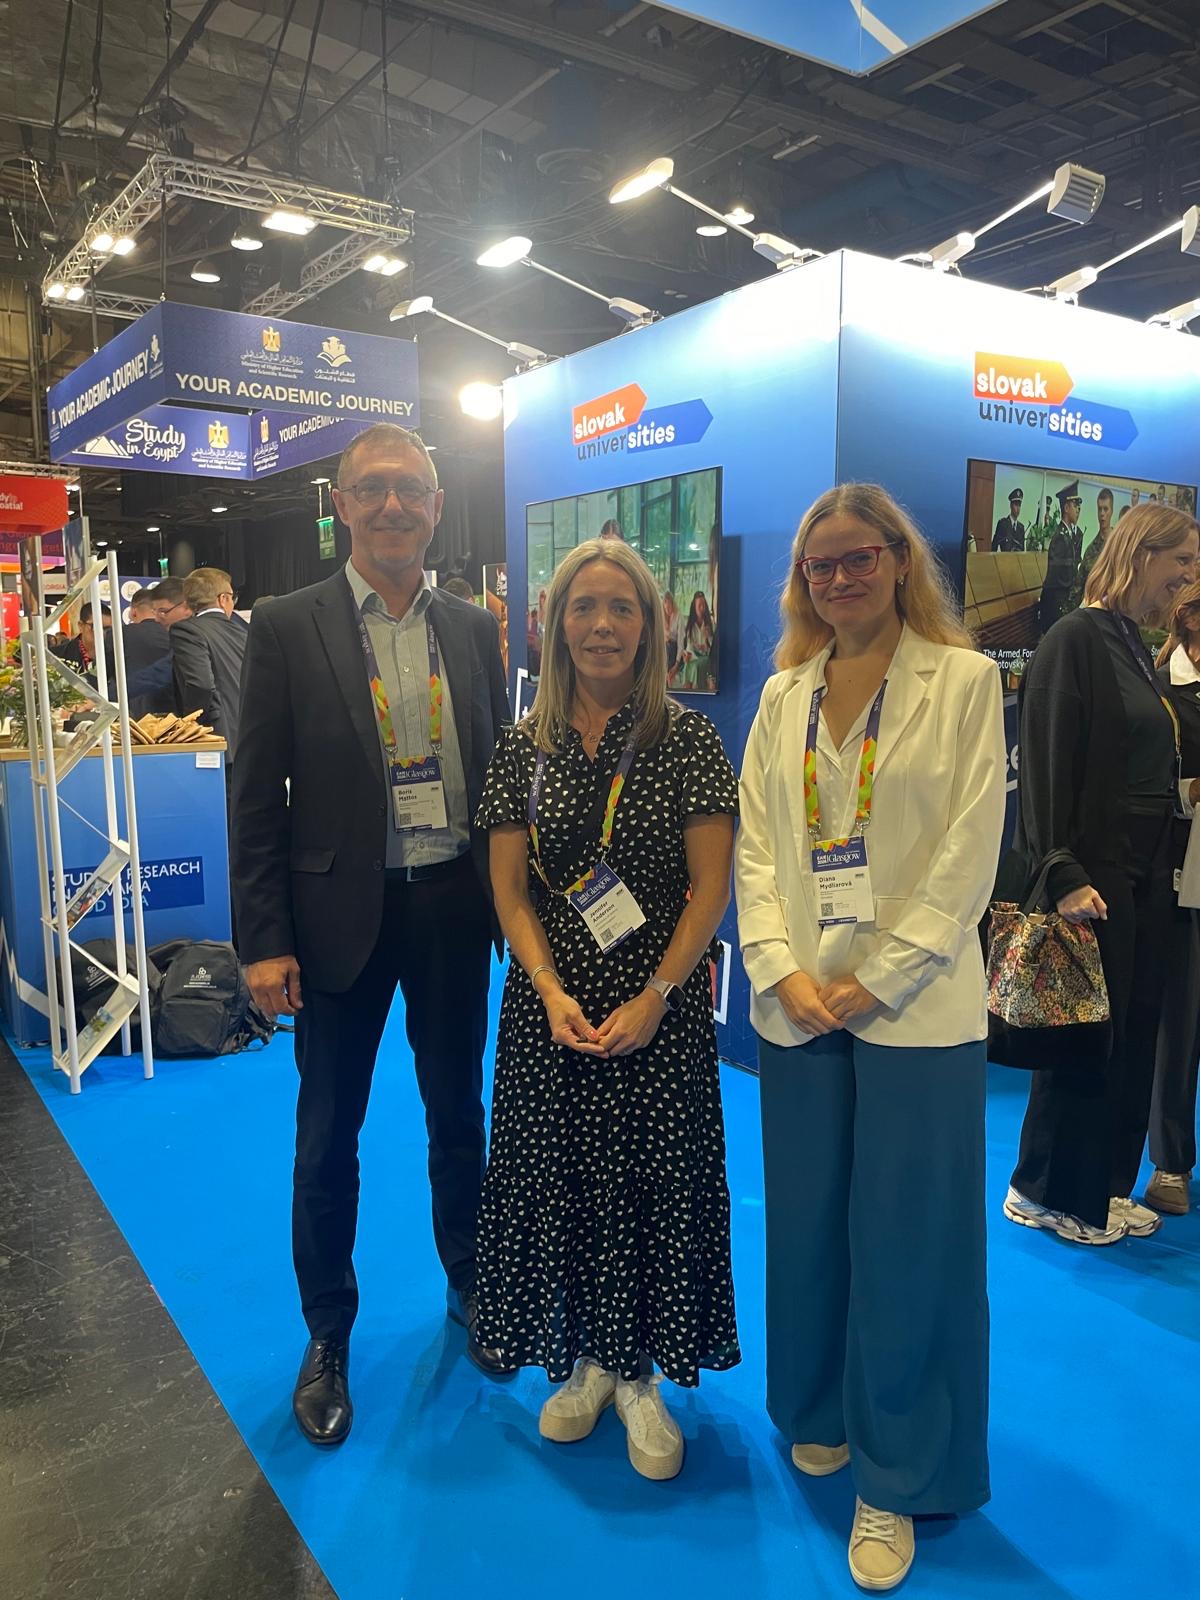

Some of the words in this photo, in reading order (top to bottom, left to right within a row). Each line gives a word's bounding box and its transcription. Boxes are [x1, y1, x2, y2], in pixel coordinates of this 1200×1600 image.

[59, 400, 77, 429] YOUR
[76, 376, 111, 419] ACADEMIC
[111, 349, 149, 395] JOURNEY
[176, 372, 231, 395] YOUR
[236, 381, 333, 407] ACADEMIC
[336, 394, 414, 417] JOURNEY
[975, 367, 1048, 399] slovak
[125, 418, 186, 453] Study
[279, 425, 298, 443] YOUR
[574, 402, 626, 440] slovak
[979, 400, 1103, 441] universities
[127, 441, 141, 455] in
[143, 442, 179, 462] Egypt
[577, 421, 676, 461] universities
[0, 501, 23, 511] oatia!
[983, 649, 997, 658] The
[998, 649, 1021, 659] Armed
[592, 904, 615, 923] Anderson
